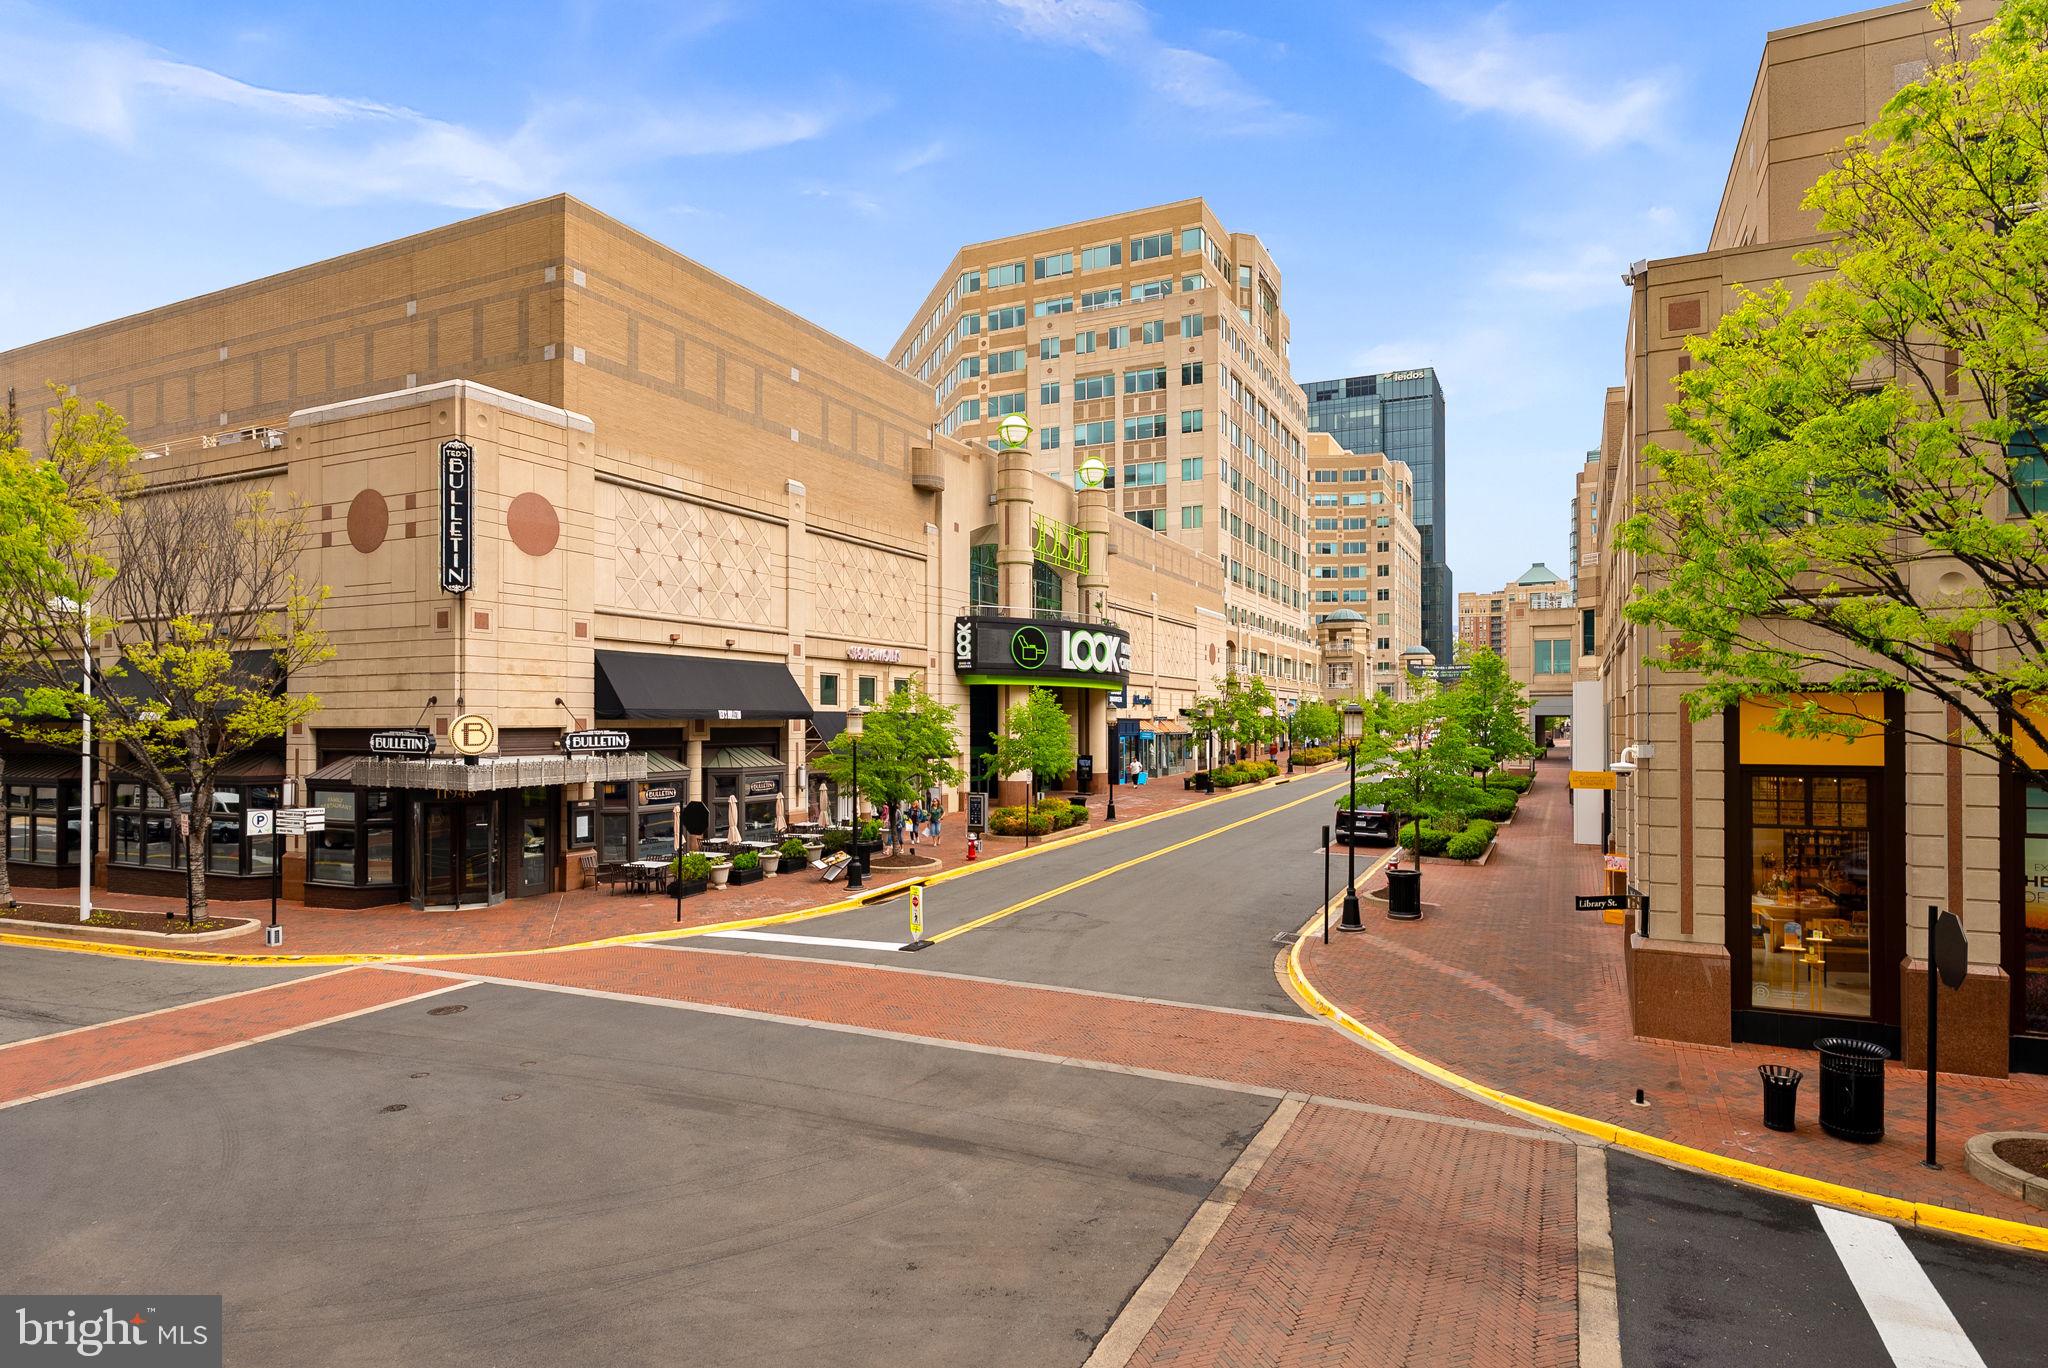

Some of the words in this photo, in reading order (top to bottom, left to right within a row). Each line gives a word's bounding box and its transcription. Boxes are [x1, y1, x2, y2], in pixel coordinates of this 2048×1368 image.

[1395, 371, 1425, 382] leidos
[446, 449, 468, 457] TED'S
[448, 458, 465, 583] BULLETIN
[957, 622, 972, 660] LOOK
[1061, 629, 1121, 674] LOOK
[461, 722, 488, 747] B
[375, 737, 424, 750] BULLETIN
[572, 736, 625, 748] BULLETIN
[1579, 899, 1606, 909] Library
[1607, 898, 1617, 907] St.
